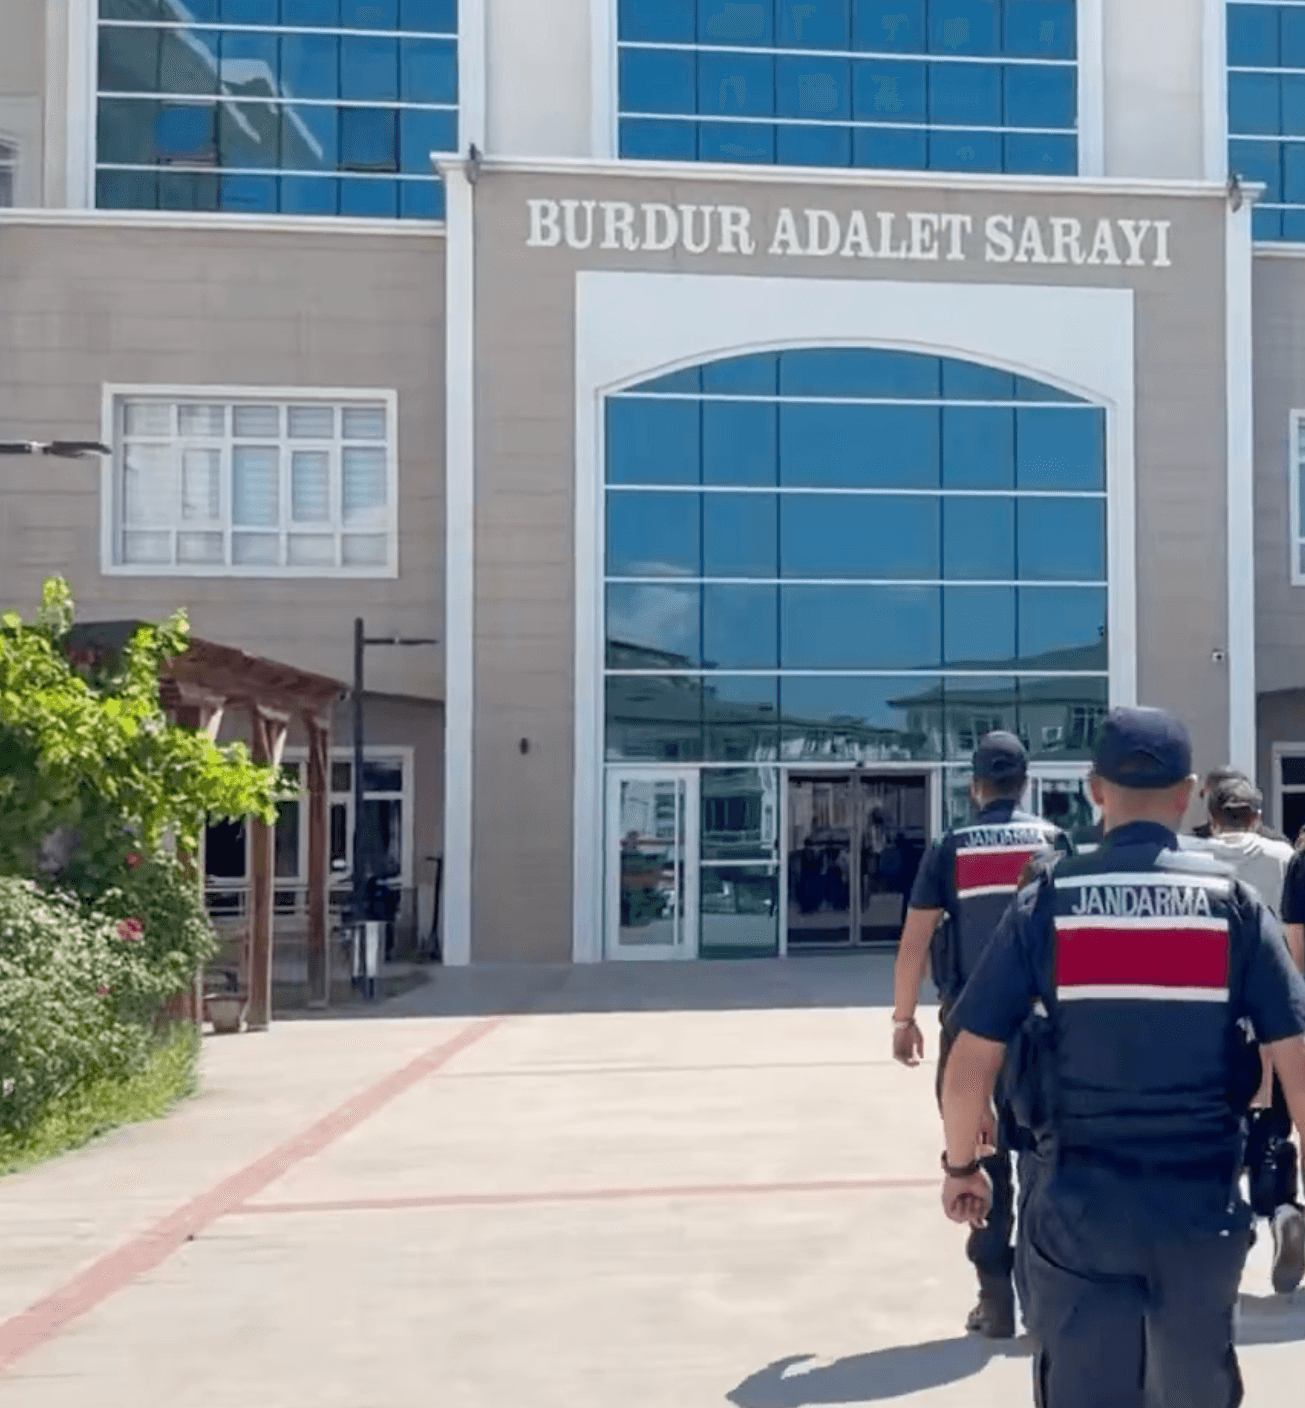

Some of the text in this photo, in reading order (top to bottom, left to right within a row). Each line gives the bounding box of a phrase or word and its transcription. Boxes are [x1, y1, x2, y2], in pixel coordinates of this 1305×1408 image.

[526, 199, 1171, 266] BURDUR ADALET SARAYI
[1072, 885, 1210, 917] JANDARMA
